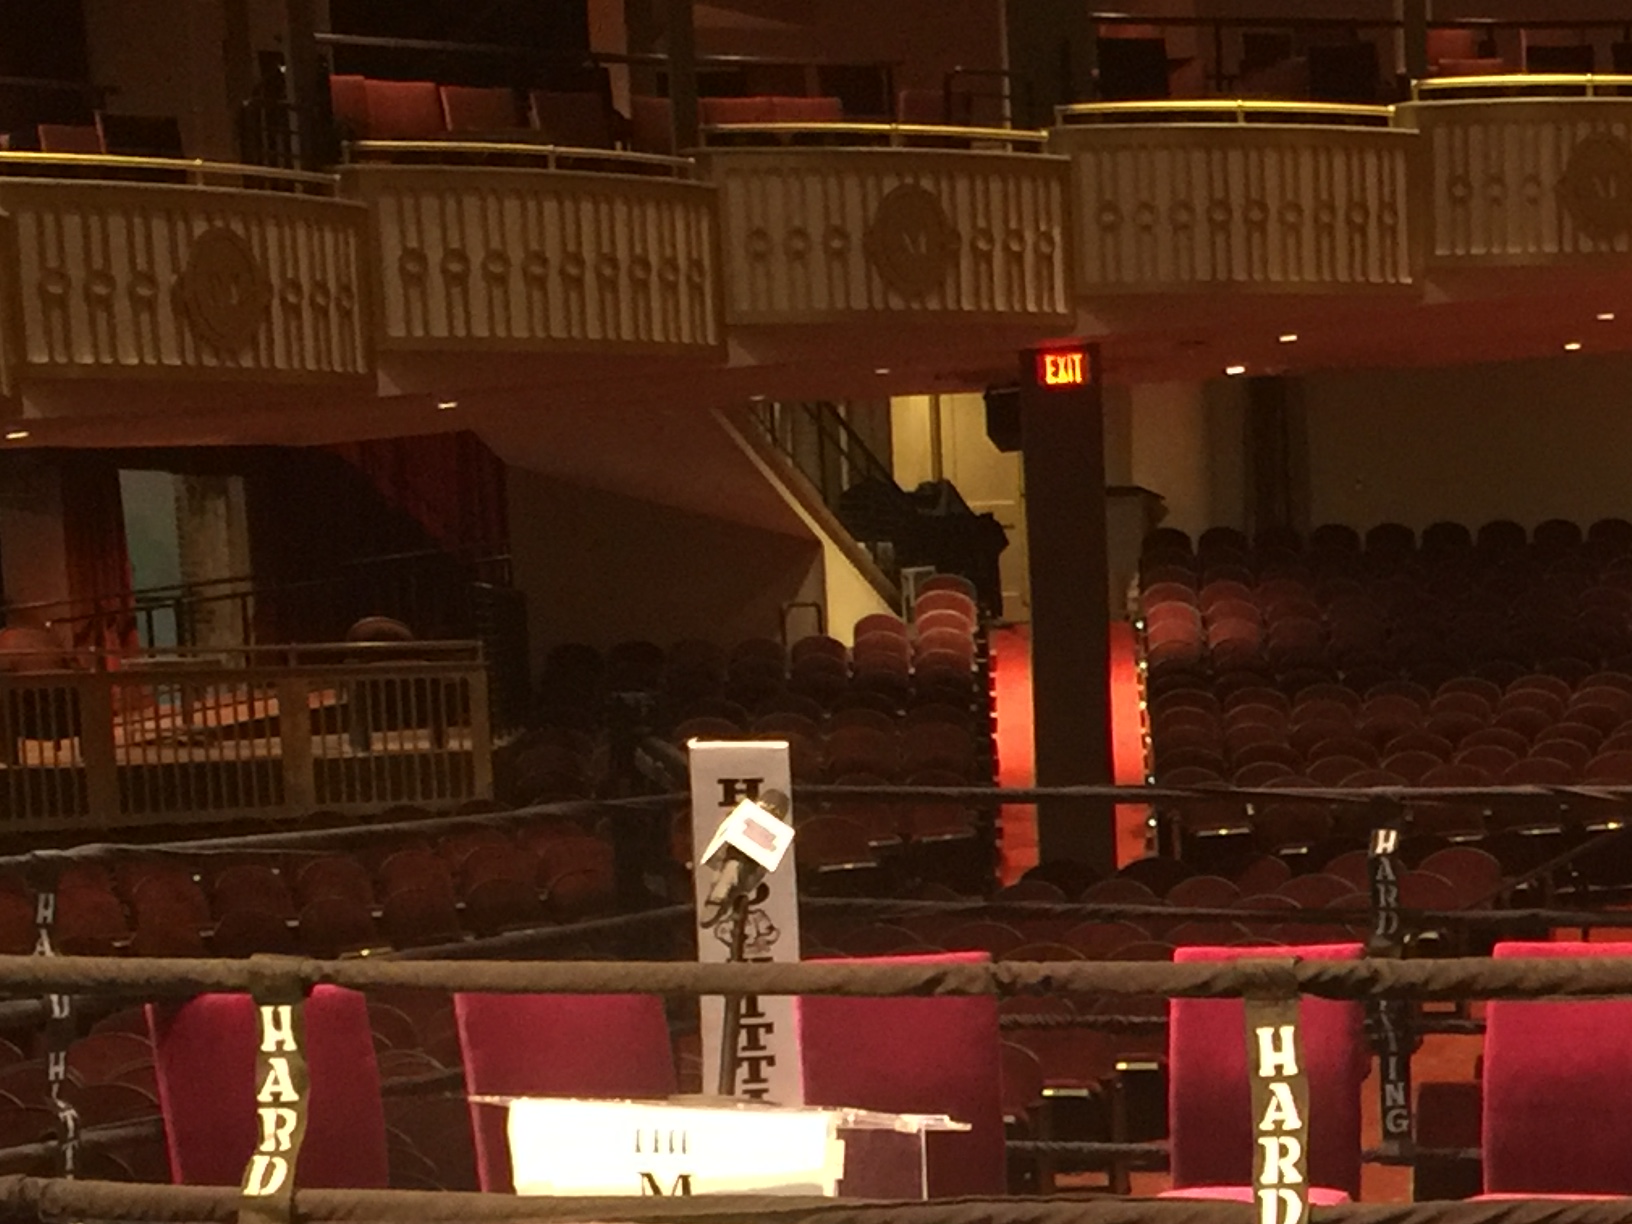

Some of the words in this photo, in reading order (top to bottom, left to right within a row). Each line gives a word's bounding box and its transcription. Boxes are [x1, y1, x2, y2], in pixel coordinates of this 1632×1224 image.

[1044, 353, 1083, 384] EXIT
[1374, 828, 1399, 936] HARD
[34, 892, 71, 1018] HAD
[241, 1004, 300, 1197] HARD
